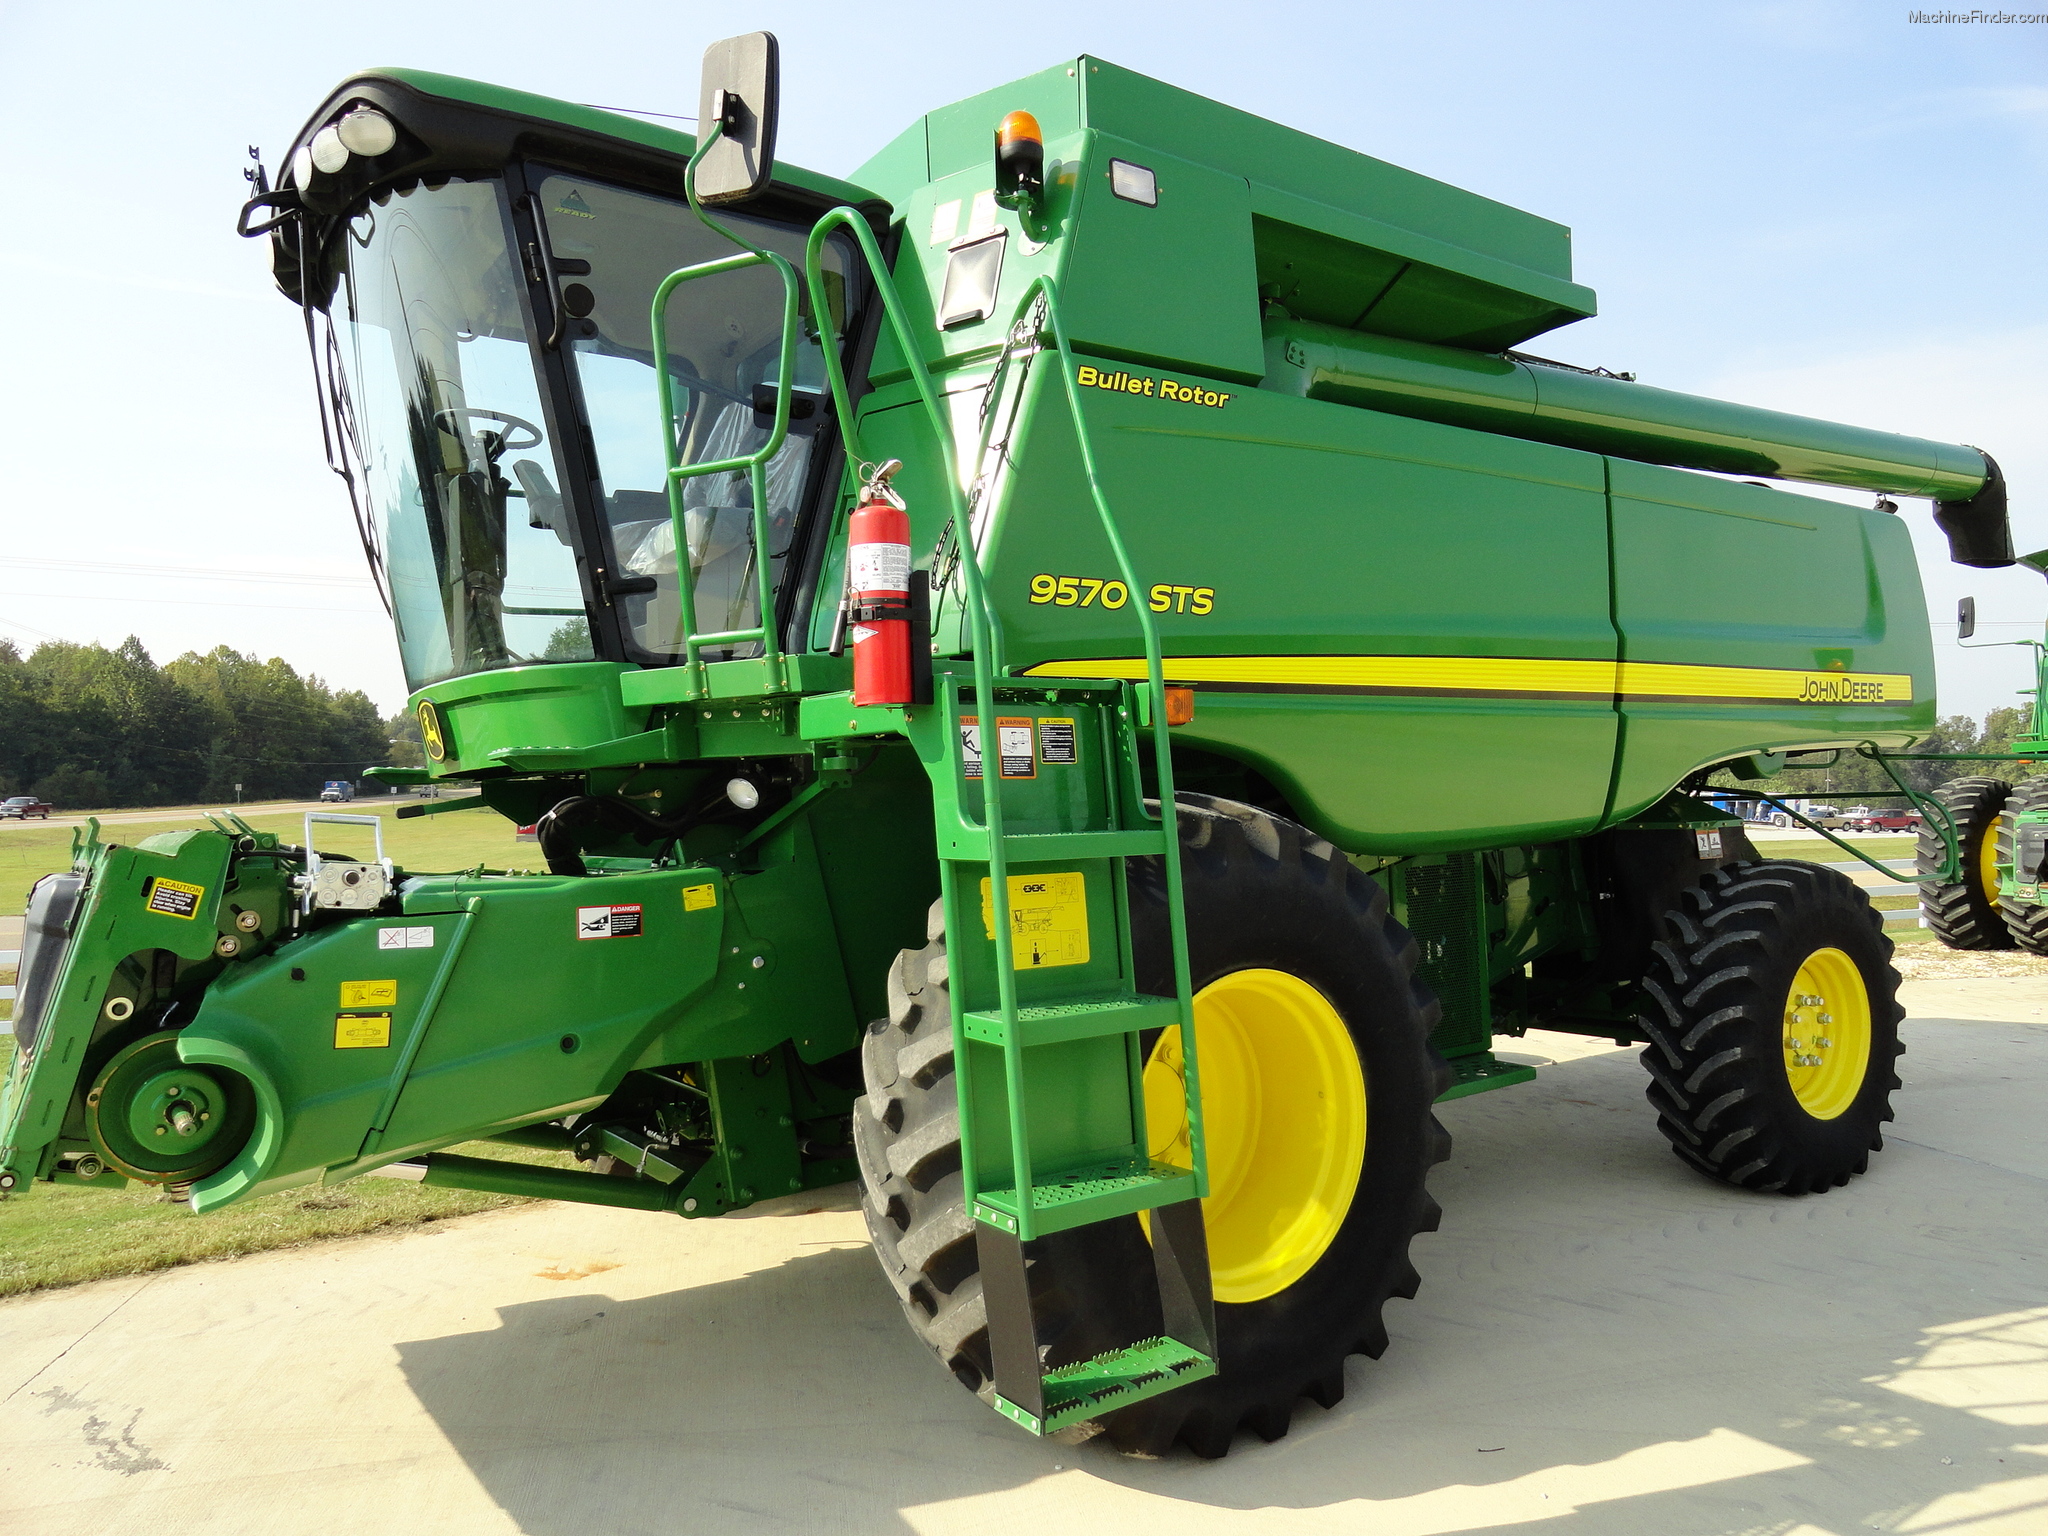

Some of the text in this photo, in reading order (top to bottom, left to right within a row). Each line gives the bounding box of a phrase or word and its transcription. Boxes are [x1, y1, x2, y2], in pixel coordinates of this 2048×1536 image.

[1077, 364, 1230, 409] Bullet Rotor
[1029, 573, 1215, 616] 9570 STS
[1799, 676, 1884, 700] JOHN DEERE
[165, 881, 202, 893] CAUTION
